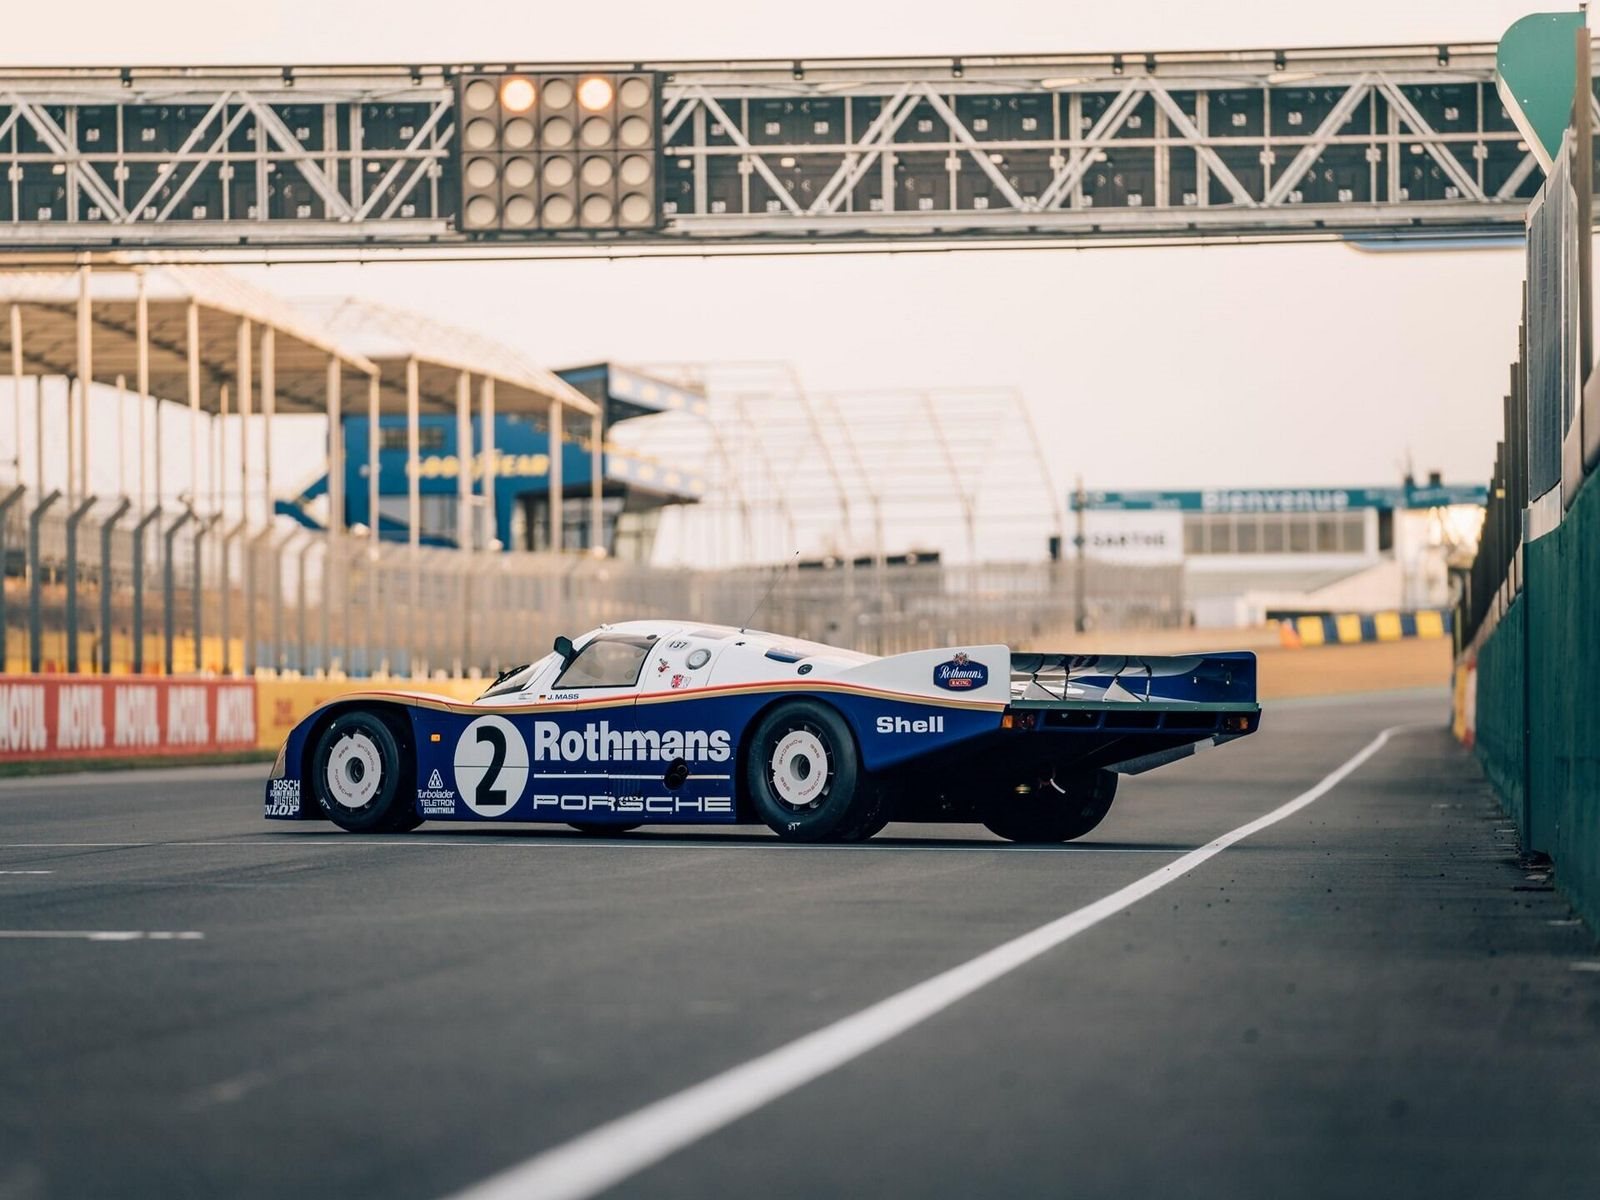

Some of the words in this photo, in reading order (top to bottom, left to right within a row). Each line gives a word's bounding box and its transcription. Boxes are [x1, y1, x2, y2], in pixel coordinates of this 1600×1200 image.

[669, 640, 687, 649] 137
[939, 664, 984, 679] Rothmans
[57, 683, 106, 750] MOTUL
[114, 684, 160, 747] MOTUL
[876, 716, 944, 733] Shell
[534, 720, 731, 762] Rothmans
[475, 725, 507, 806] 2
[273, 779, 300, 790] BOSCH
[274, 796, 300, 806] BILSTEIN
[417, 789, 455, 799] Turbolader
[420, 799, 455, 807] TELETRON
[533, 795, 731, 812] PORSCHE
